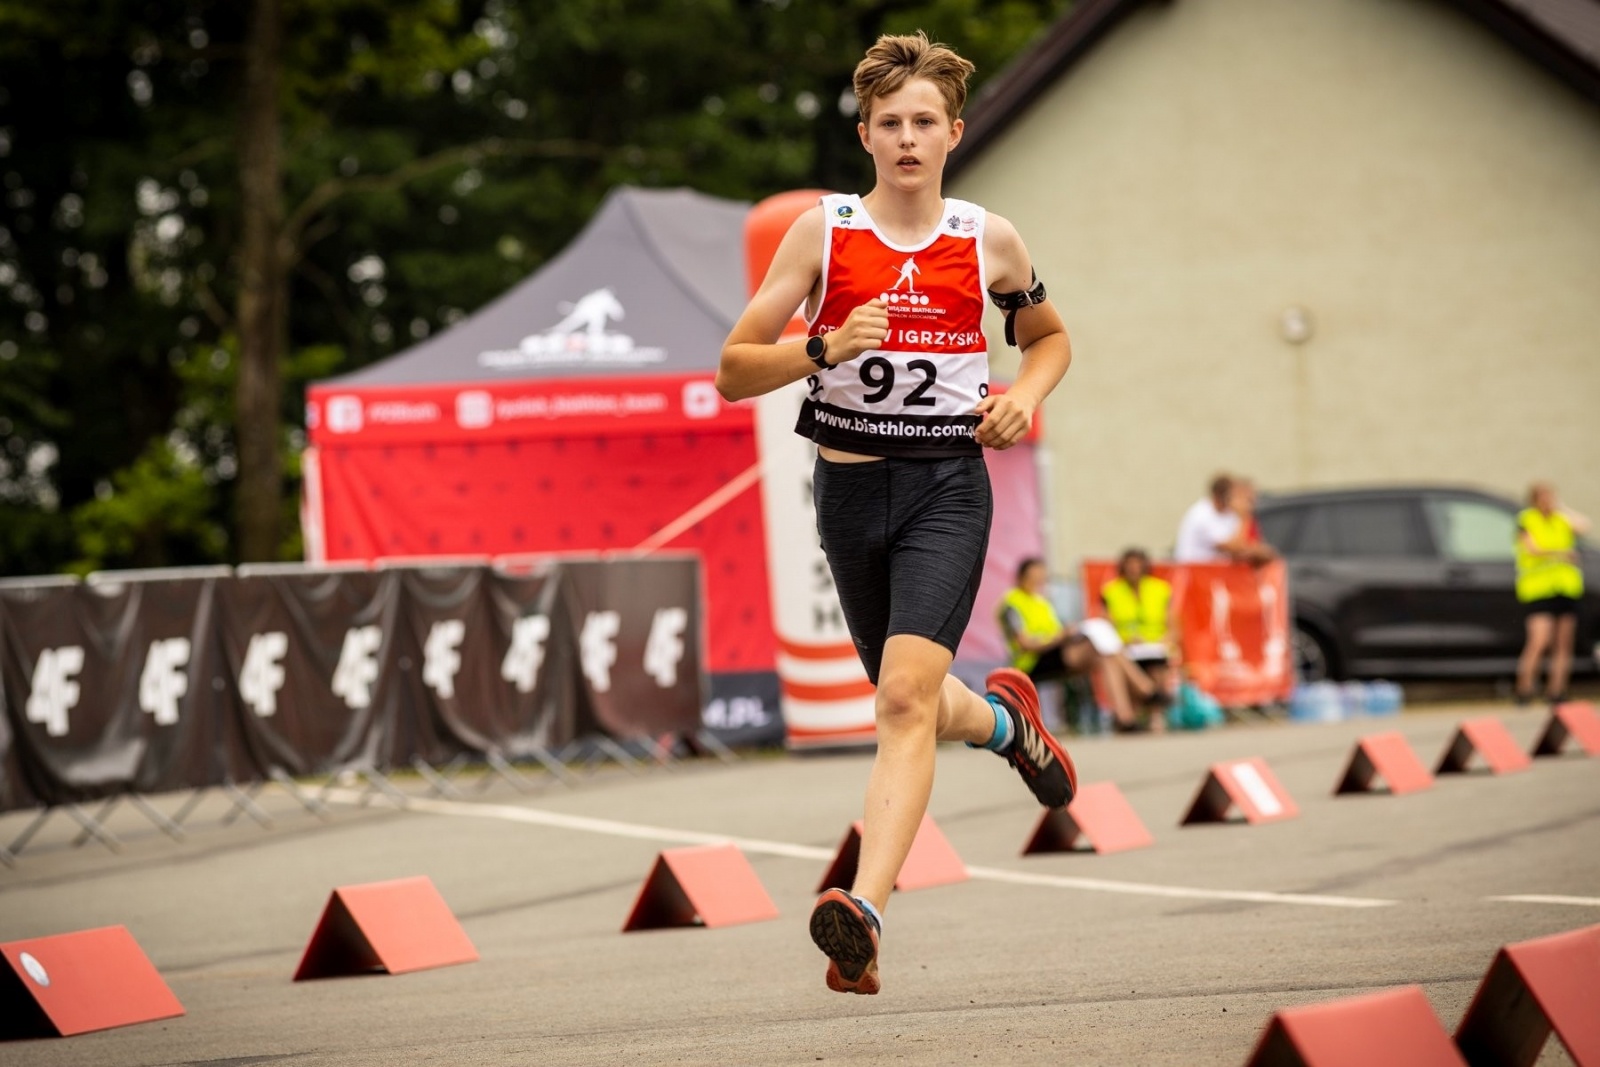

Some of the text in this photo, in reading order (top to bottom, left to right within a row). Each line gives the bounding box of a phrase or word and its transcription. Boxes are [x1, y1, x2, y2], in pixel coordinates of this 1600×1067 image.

[858, 356, 938, 407] 92
[28, 646, 84, 735] 4F
[140, 637, 191, 724] 4F
[240, 632, 288, 716] 4F
[332, 626, 383, 709] 4F
